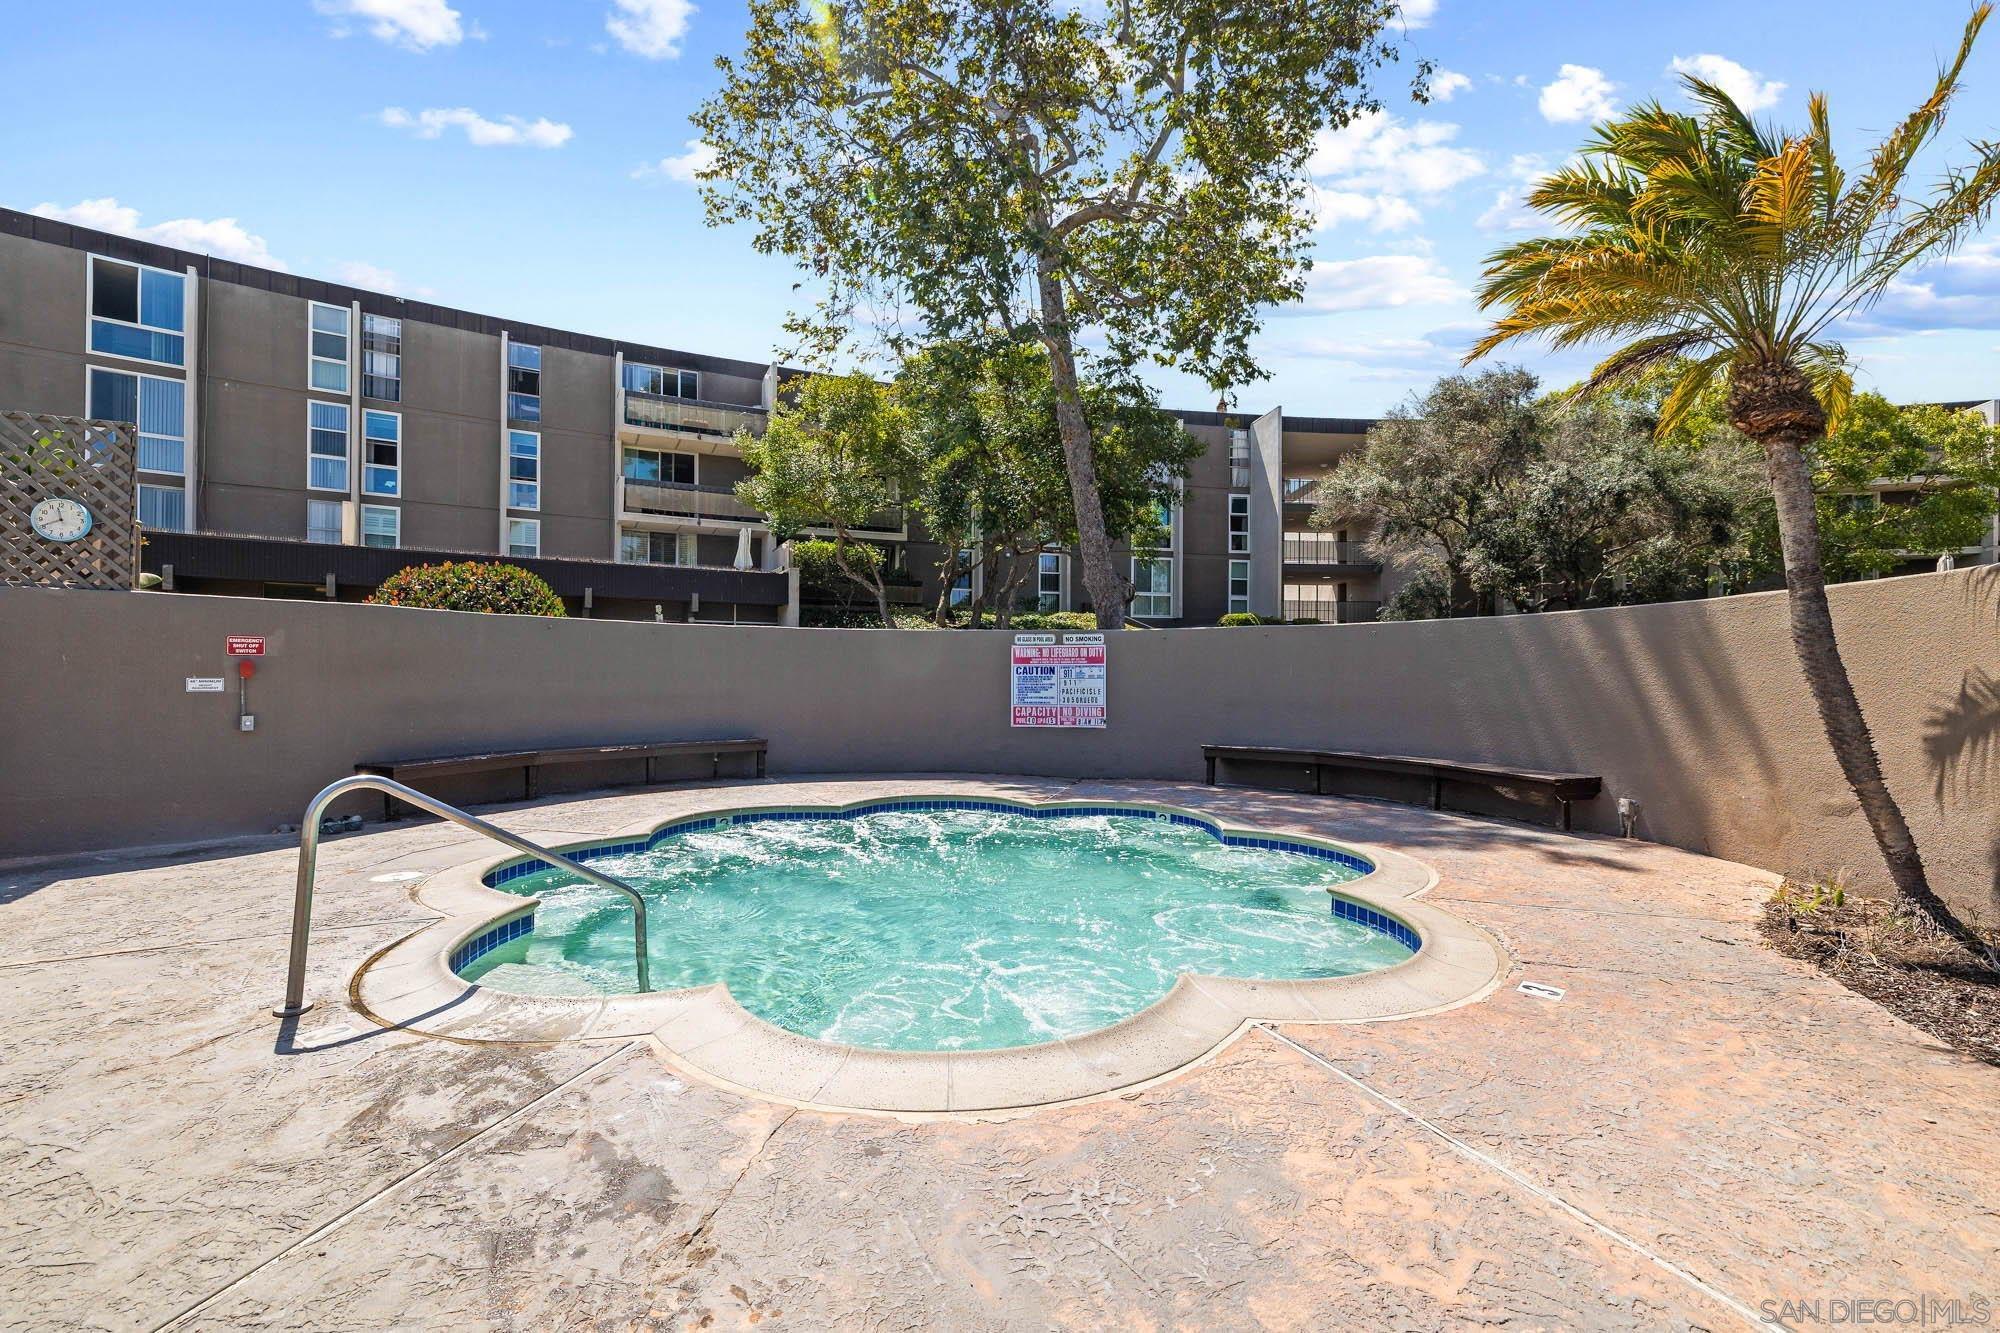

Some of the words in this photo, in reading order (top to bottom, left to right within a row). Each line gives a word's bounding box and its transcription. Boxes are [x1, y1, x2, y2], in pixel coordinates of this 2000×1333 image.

[1042, 647, 1050, 658] NO
[1051, 647, 1079, 657] LIFEGUARD
[1080, 647, 1088, 657] ON
[1088, 647, 1103, 657] DUTY
[1016, 666, 1056, 675] CAUTION
[1063, 669, 1073, 678] 911
[1015, 707, 1057, 717] CAPACITY
[1062, 707, 1073, 717] NO
[1076, 707, 1102, 717] DIVING
[1521, 984, 1561, 997] 3
